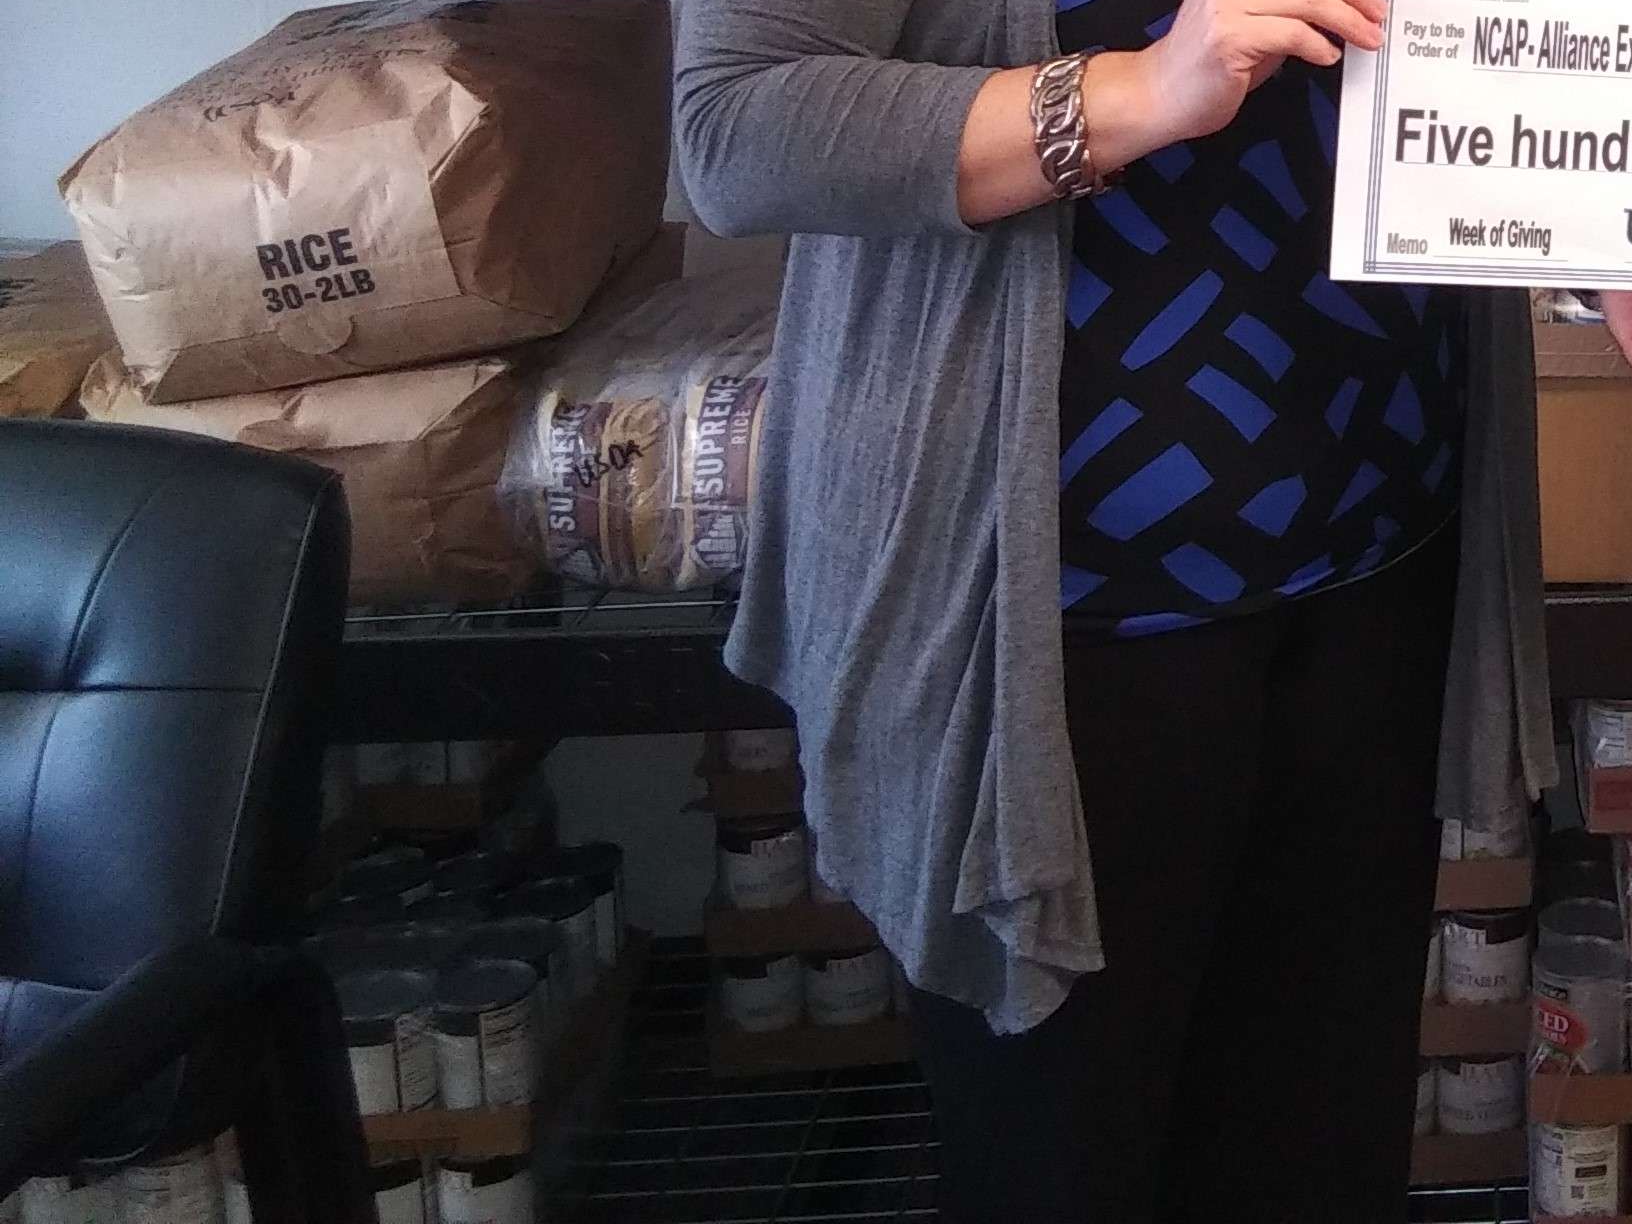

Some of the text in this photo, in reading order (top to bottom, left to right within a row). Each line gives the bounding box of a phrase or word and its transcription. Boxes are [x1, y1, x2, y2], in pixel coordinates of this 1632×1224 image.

[1404, 20, 1465, 40] Pay to the
[1407, 41, 1459, 59] Order of
[1473, 15, 1535, 67] NCAP-
[1538, 21, 1609, 71] Alliance
[1395, 108, 1493, 166] Five
[256, 227, 359, 282] RICE
[1387, 232, 1428, 256] Memo
[1449, 216, 1486, 247] Week
[1490, 218, 1505, 248] of
[1508, 222, 1552, 257] Giving
[262, 269, 376, 315] 30-2LB
[730, 407, 752, 446] RICE
